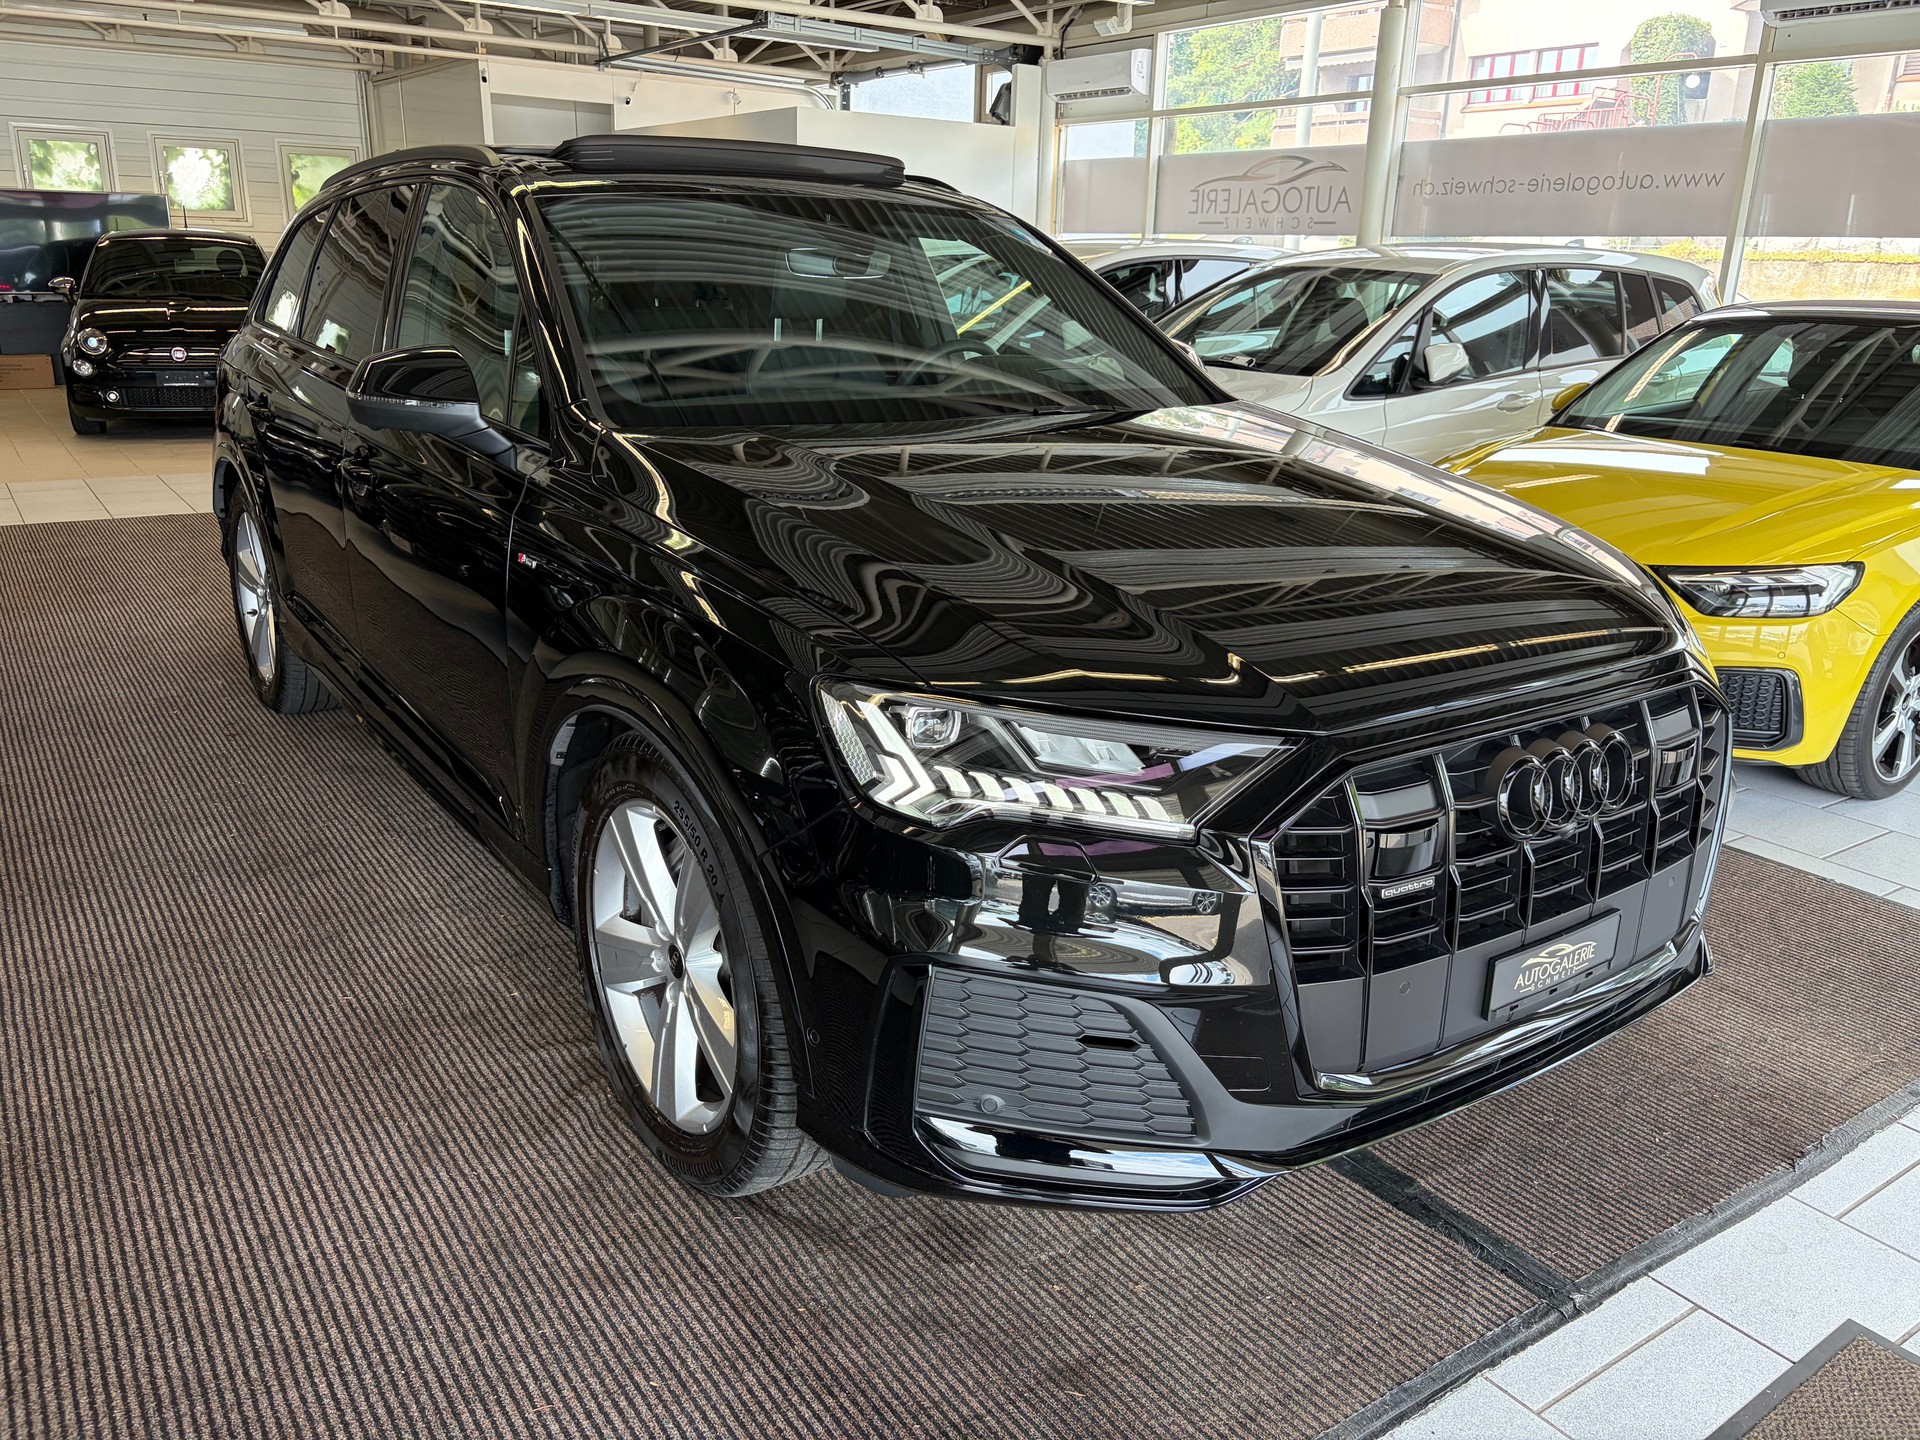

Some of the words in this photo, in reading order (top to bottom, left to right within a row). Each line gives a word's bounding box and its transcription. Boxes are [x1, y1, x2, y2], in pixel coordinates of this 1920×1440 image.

[673, 800, 701, 848] 255/50
[700, 847, 708, 864] R
[706, 864, 718, 887] 20
[1384, 879, 1434, 898] quattro
[1514, 944, 1596, 990] AUTOGALERIE
[1531, 967, 1577, 991] SCHWEIZ
